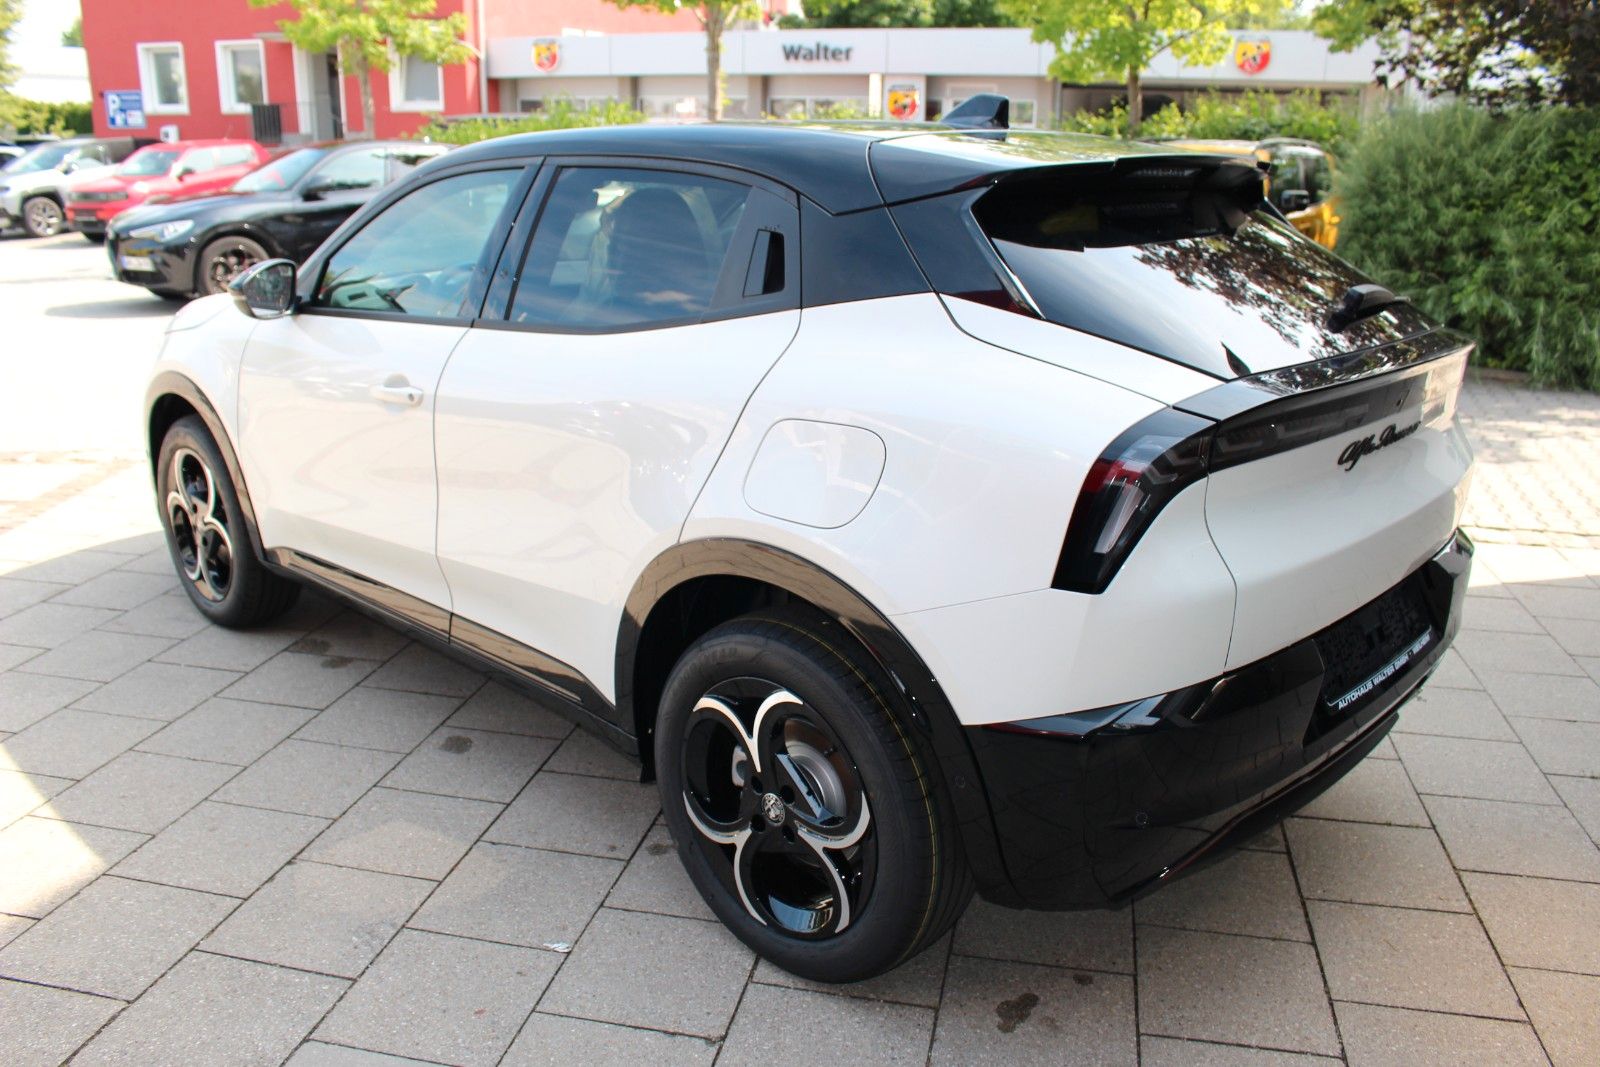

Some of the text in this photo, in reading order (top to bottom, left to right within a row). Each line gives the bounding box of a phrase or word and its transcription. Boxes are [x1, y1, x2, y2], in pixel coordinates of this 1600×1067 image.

[783, 42, 853, 61] Walter
[1338, 682, 1373, 710] AUTOHAUS
[1372, 665, 1396, 686] WALTER
